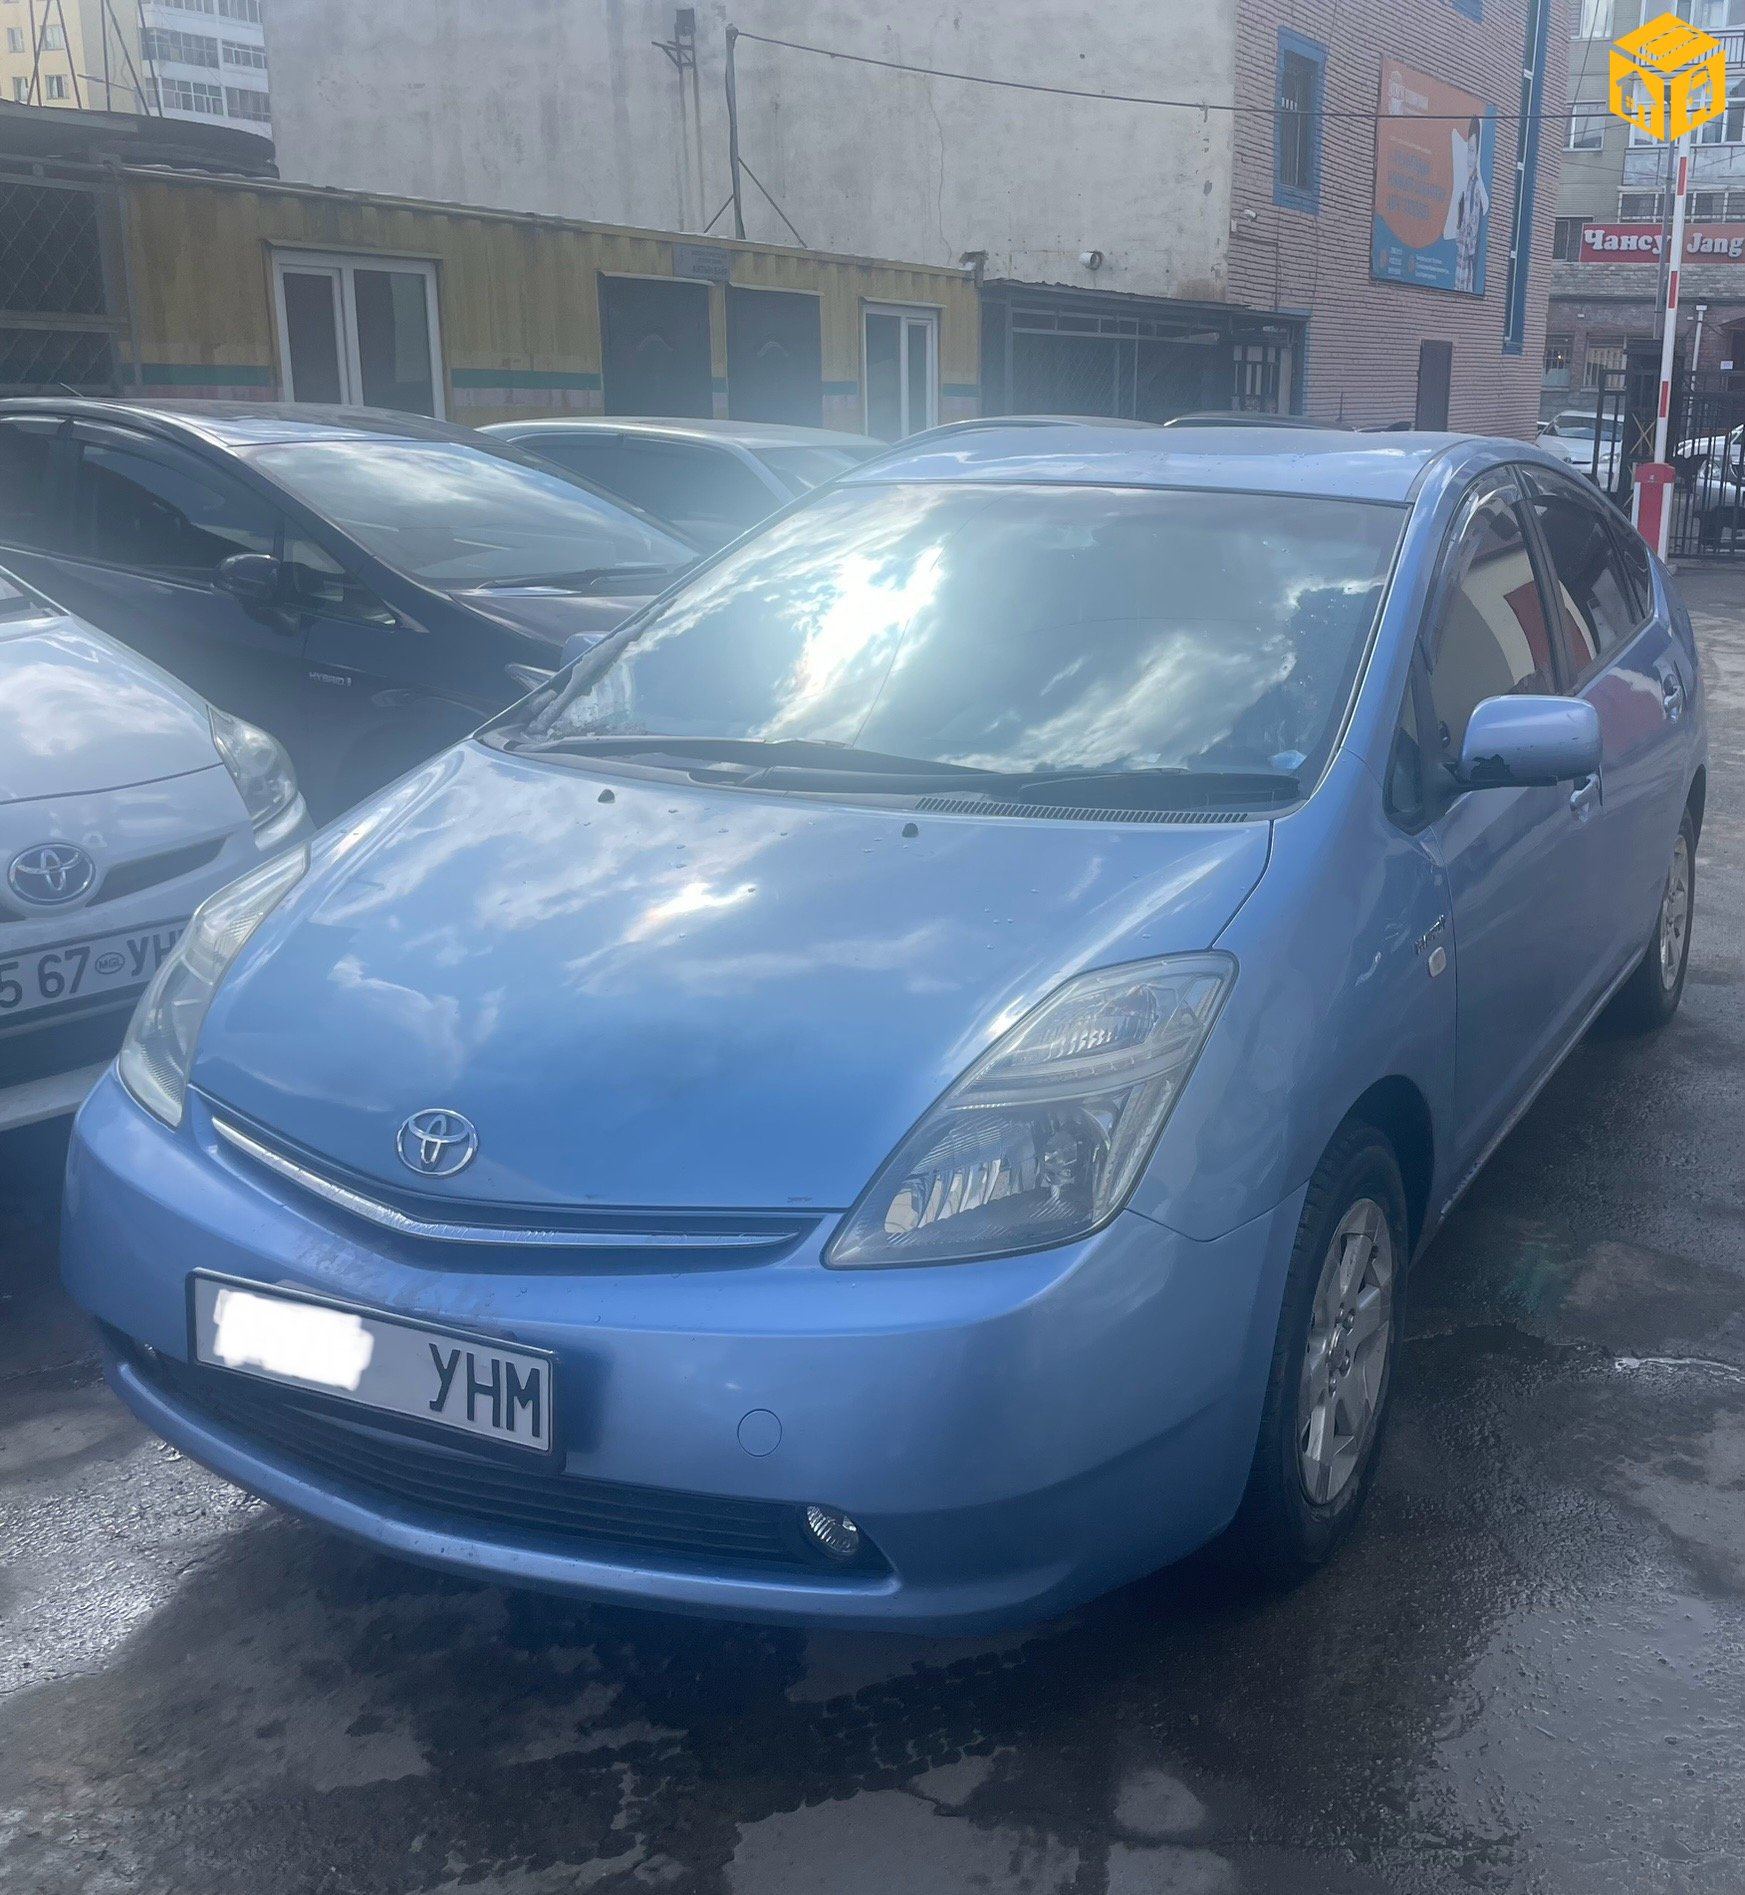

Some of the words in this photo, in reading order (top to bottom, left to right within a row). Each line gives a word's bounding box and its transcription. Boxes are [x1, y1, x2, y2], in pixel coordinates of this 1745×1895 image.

[1584, 229, 1671, 255] Чансу
[37, 946, 91, 999] 67
[428, 1342, 541, 1438] УНМ
